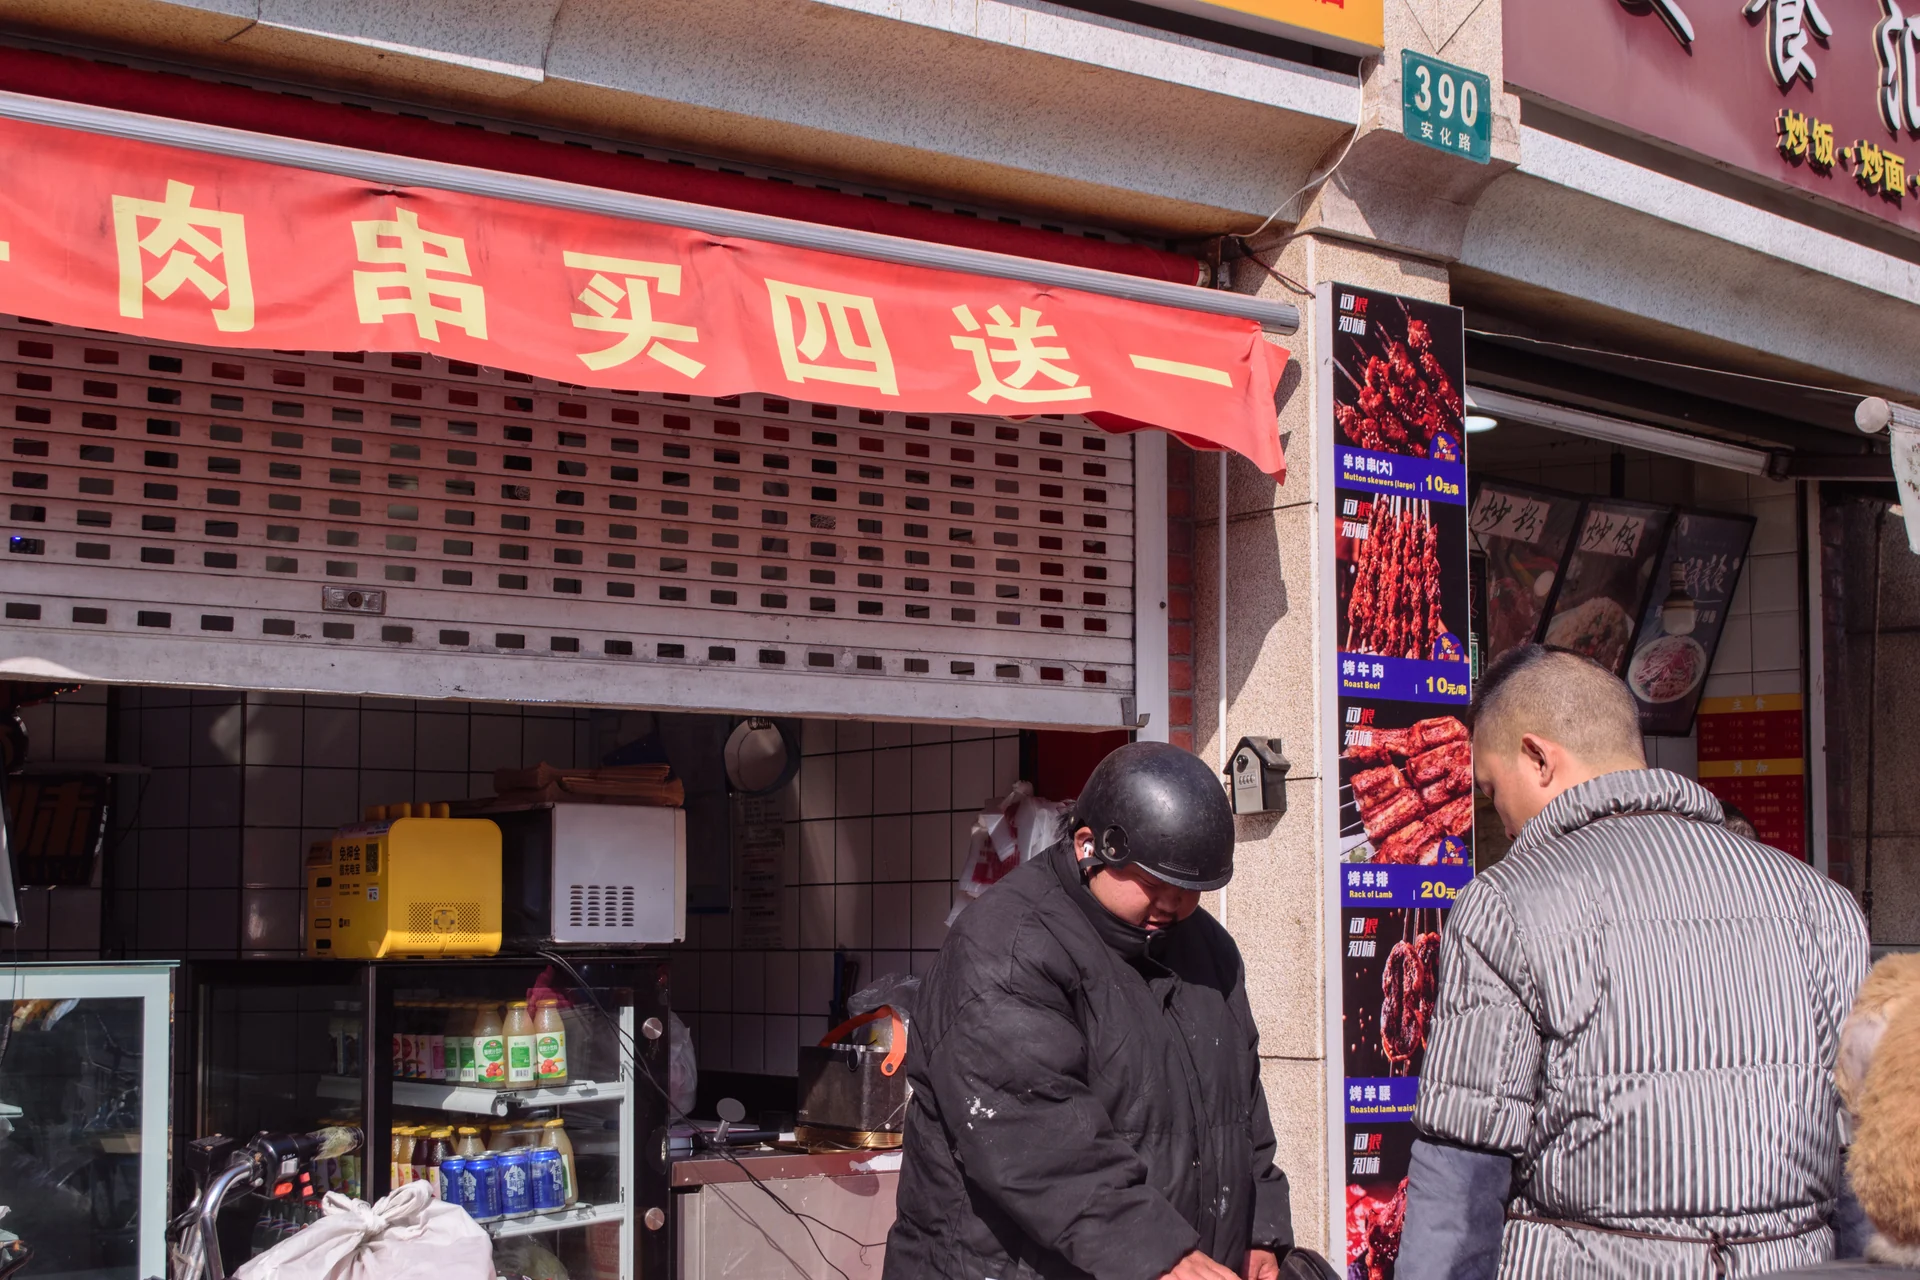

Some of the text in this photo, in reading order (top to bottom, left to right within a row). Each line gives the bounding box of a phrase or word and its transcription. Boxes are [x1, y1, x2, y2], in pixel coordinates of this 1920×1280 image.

[1414, 65, 1478, 127] 390
[1420, 121, 1471, 152] 安化路
[0, 178, 1233, 403] 肉串买四送一
[1338, 315, 1366, 335] 知味
[1343, 454, 1392, 476] 羊肉串(大)
[1343, 472, 1415, 491] Mutton skewers (large)
[1341, 521, 1369, 539] 知味
[1343, 660, 1384, 678] 烤牛肉
[1343, 679, 1380, 690] Roast Beef
[1344, 729, 1373, 746] 知味
[339, 845, 361, 862] 免押金
[1347, 871, 1388, 887] 烤羊排
[1349, 890, 1393, 898] Rack of Lamb
[1347, 941, 1376, 957] 知味
[1349, 1085, 1390, 1101] 烤羊腰
[1350, 1105, 1378, 1113] Roasted
[1379, 1105, 1396, 1113] lamb
[1352, 1157, 1380, 1174] 知味
